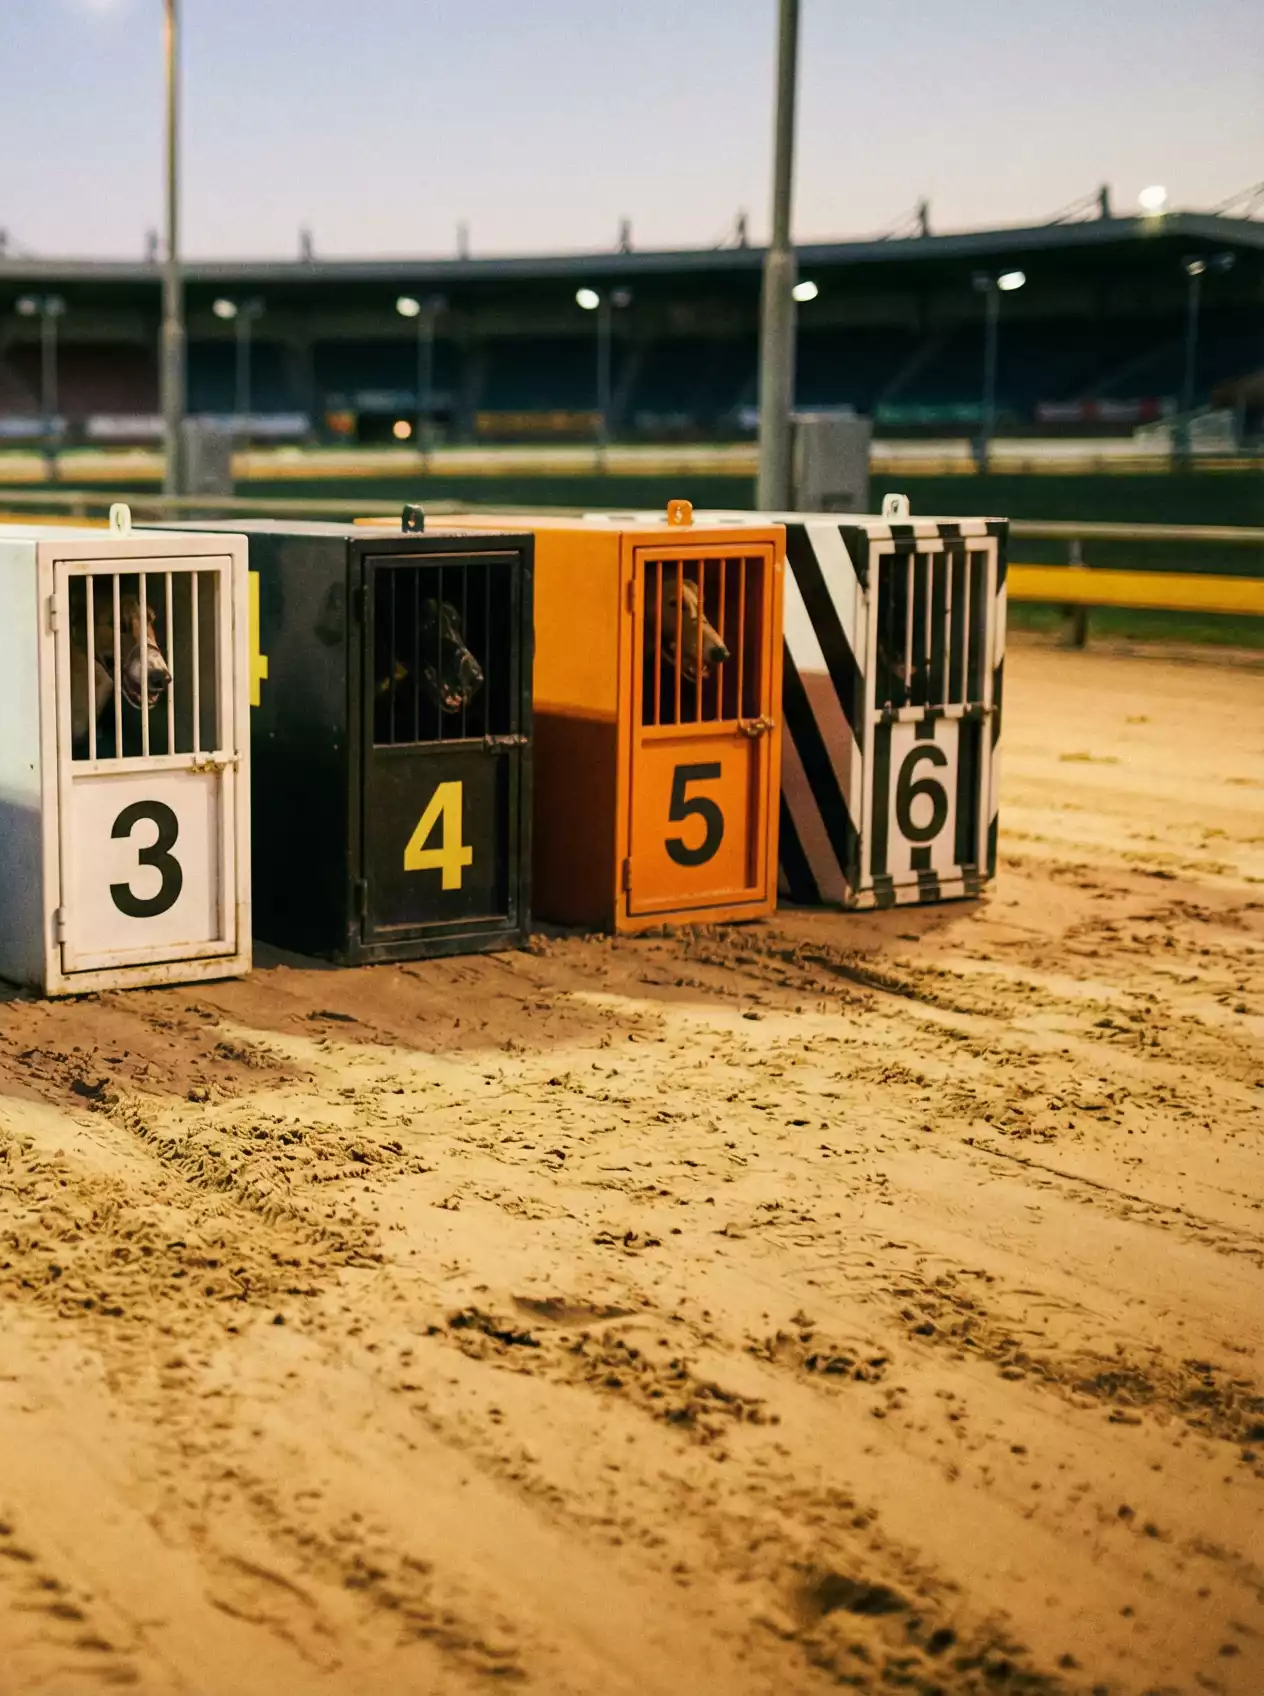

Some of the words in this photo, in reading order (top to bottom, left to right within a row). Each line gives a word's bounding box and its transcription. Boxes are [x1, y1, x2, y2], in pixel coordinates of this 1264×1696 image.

[403, 780, 473, 890] 4
[664, 762, 724, 866] 5
[895, 743, 948, 842] 6
[109, 800, 183, 918] 3
